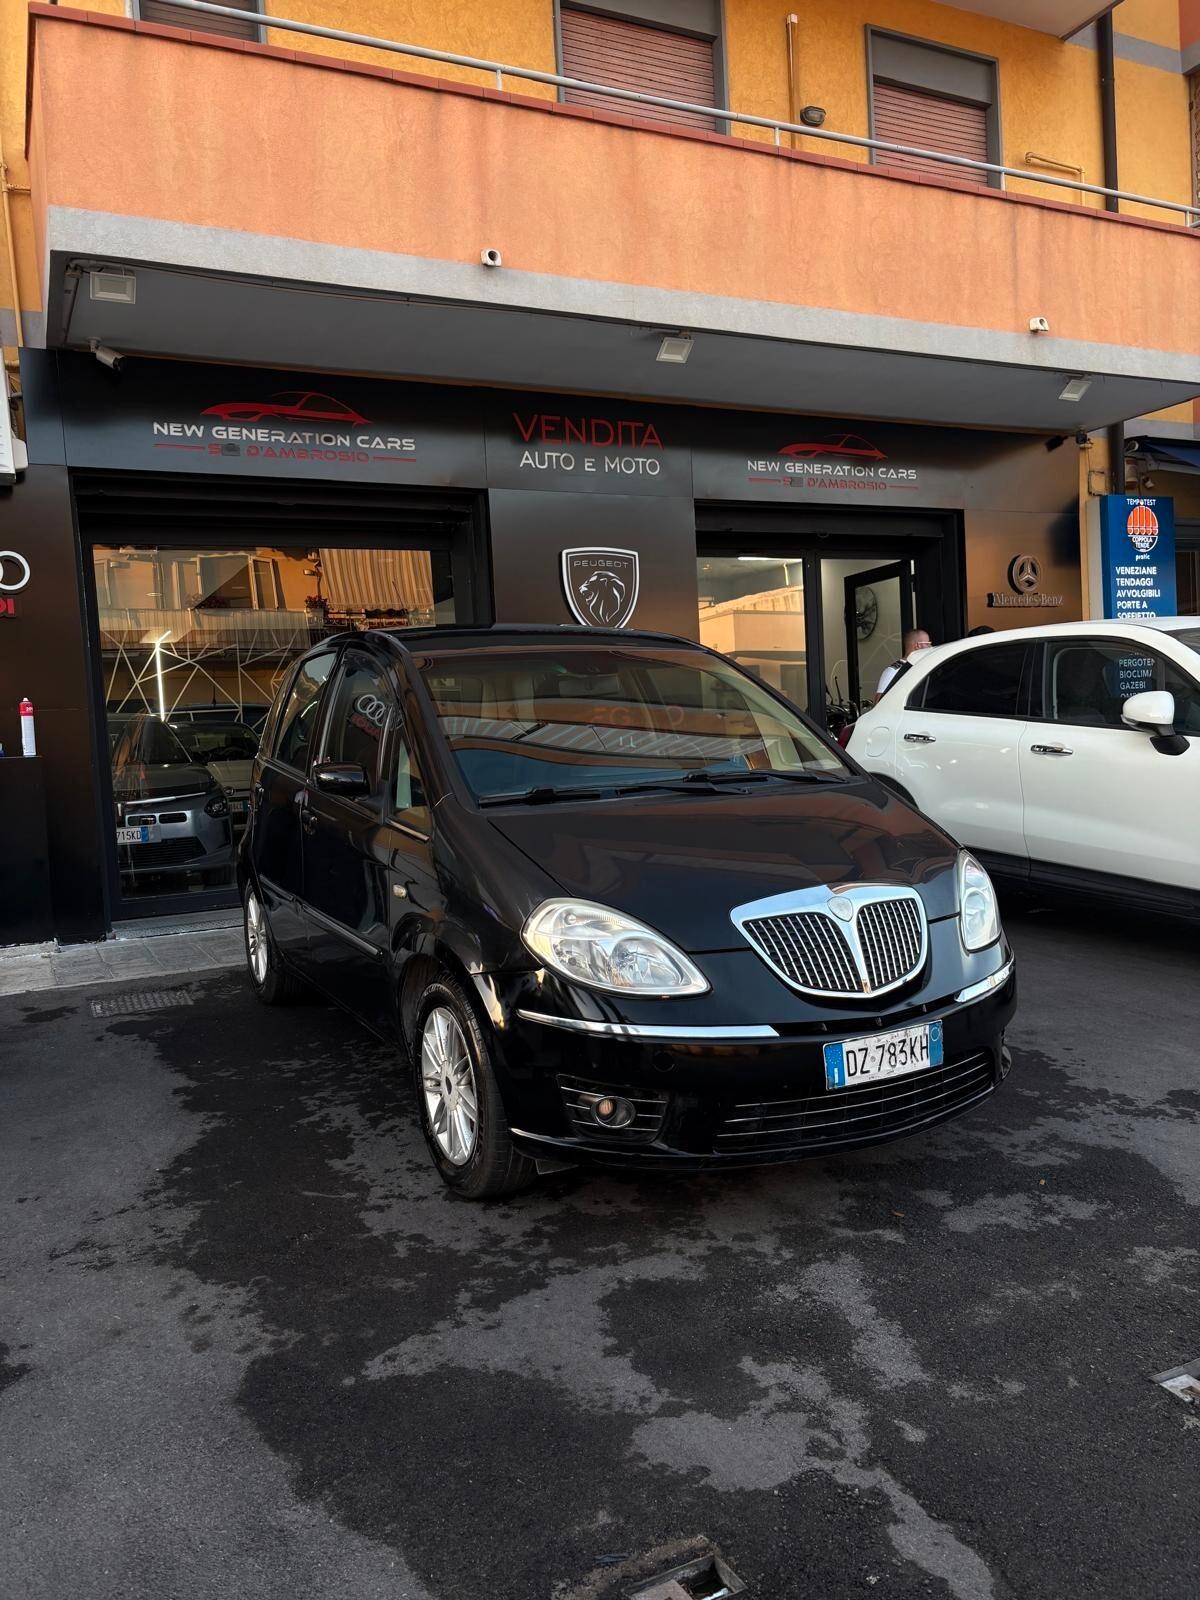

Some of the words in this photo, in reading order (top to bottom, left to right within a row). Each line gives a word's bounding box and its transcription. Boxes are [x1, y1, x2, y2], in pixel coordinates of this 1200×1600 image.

[153, 421, 204, 438] NEW
[212, 427, 350, 448] GENERATION
[356, 435, 416, 450] CARS
[512, 412, 664, 450] VENDITA
[246, 445, 370, 462] D'AMBROSIO
[519, 450, 575, 471] AUTO
[584, 458, 596, 472] E
[604, 456, 660, 476] MOTO
[747, 460, 780, 472] NEW
[785, 462, 874, 478] GENERATION
[878, 467, 917, 480] CARS
[807, 478, 887, 491] D'AMBROSIO
[573, 560, 629, 569] PEUGEOT
[1115, 566, 1157, 575] VENEZIANE
[1116, 577, 1154, 587] TENDAGGI
[990, 592, 1063, 608] Mercedes-Benz
[1116, 589, 1161, 598] AVVOLGIBILI
[1117, 600, 1140, 609] PORTE
[1142, 600, 1148, 609] A
[1120, 680, 1146, 690] GAZEBI
[845, 1047, 870, 1077] DZ
[876, 1033, 930, 1073] 783KH
